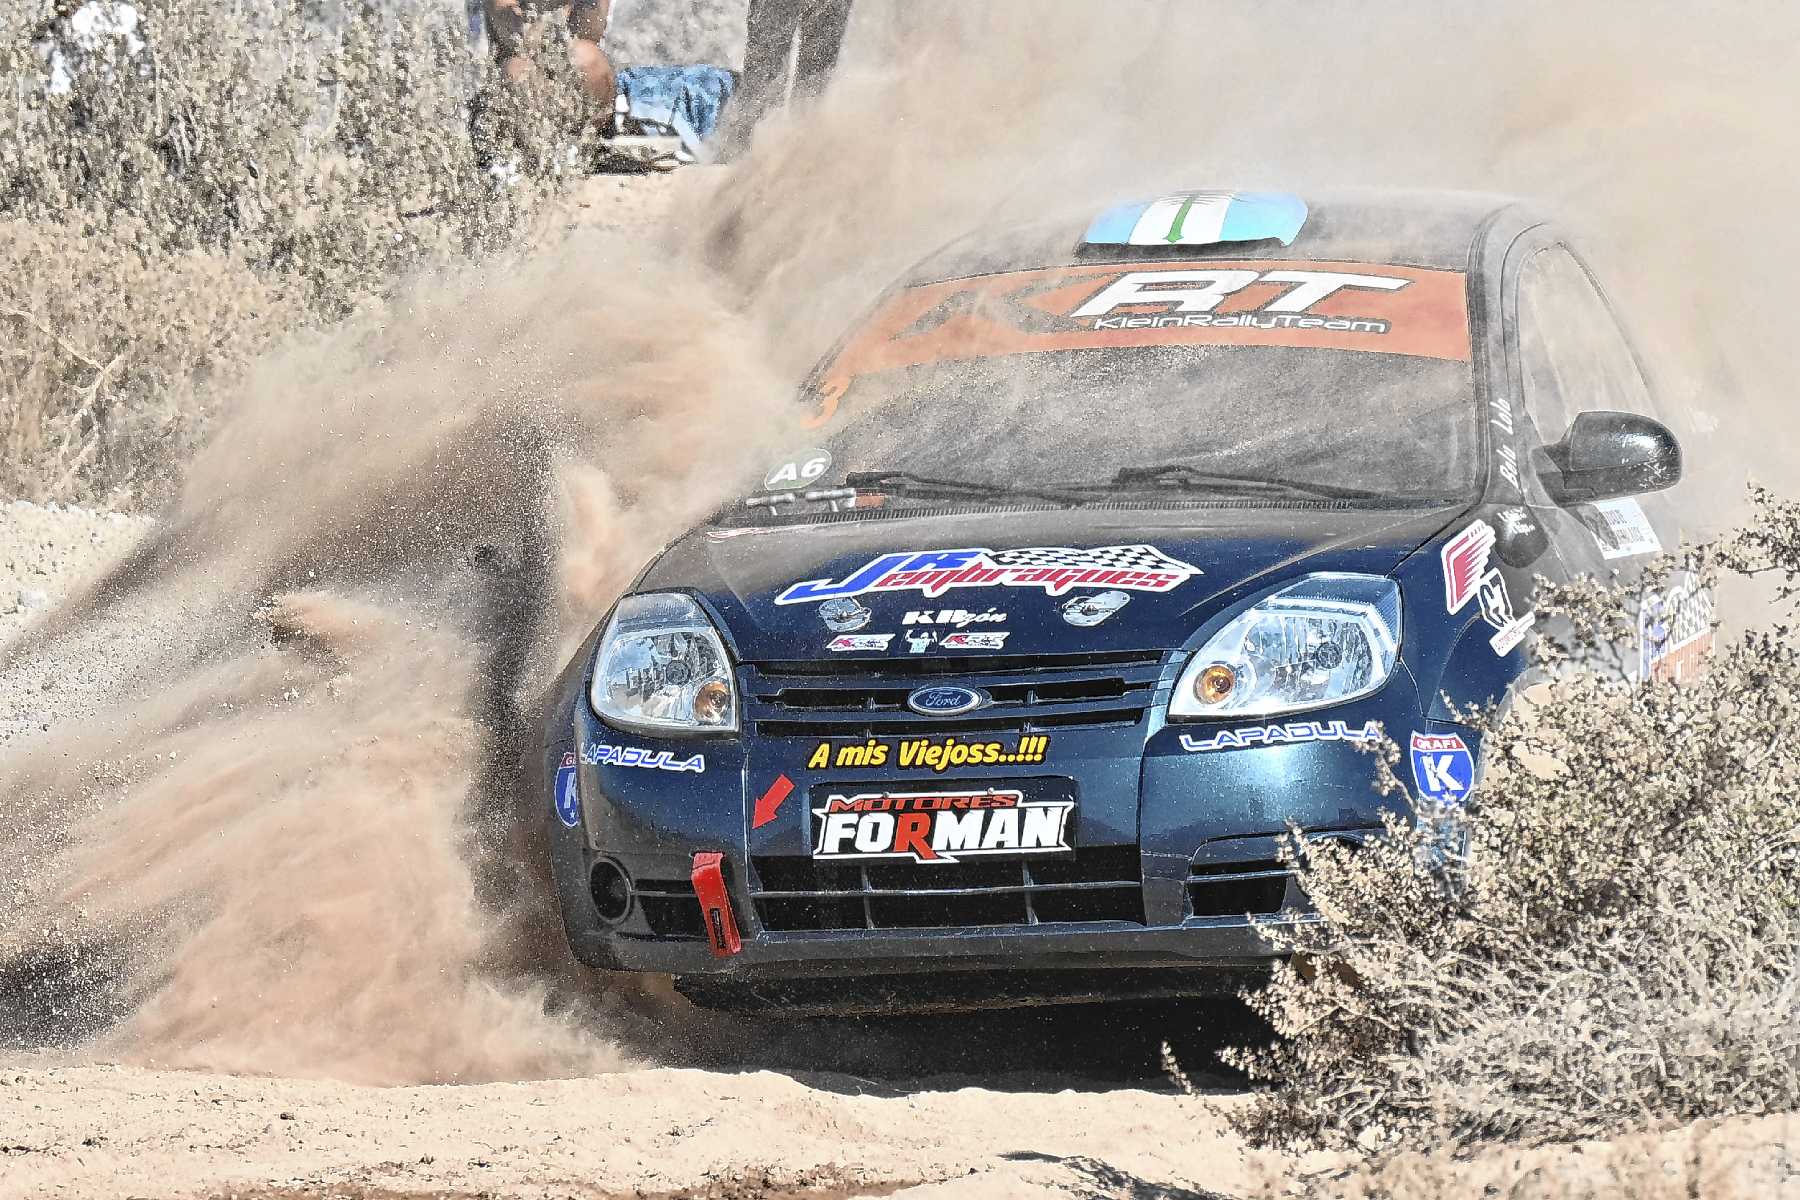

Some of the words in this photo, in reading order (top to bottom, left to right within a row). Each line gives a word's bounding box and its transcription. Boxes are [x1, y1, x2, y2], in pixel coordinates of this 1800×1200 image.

[766, 457, 827, 485] A6
[925, 689, 962, 706] Ford
[1179, 720, 1383, 751] LAPADULA
[579, 742, 706, 773] LAPADULA
[808, 743, 829, 769] A
[835, 739, 889, 767] mis
[1421, 754, 1465, 792] K
[828, 793, 1018, 813] MOTORES
[823, 806, 1065, 861] FORMAN
